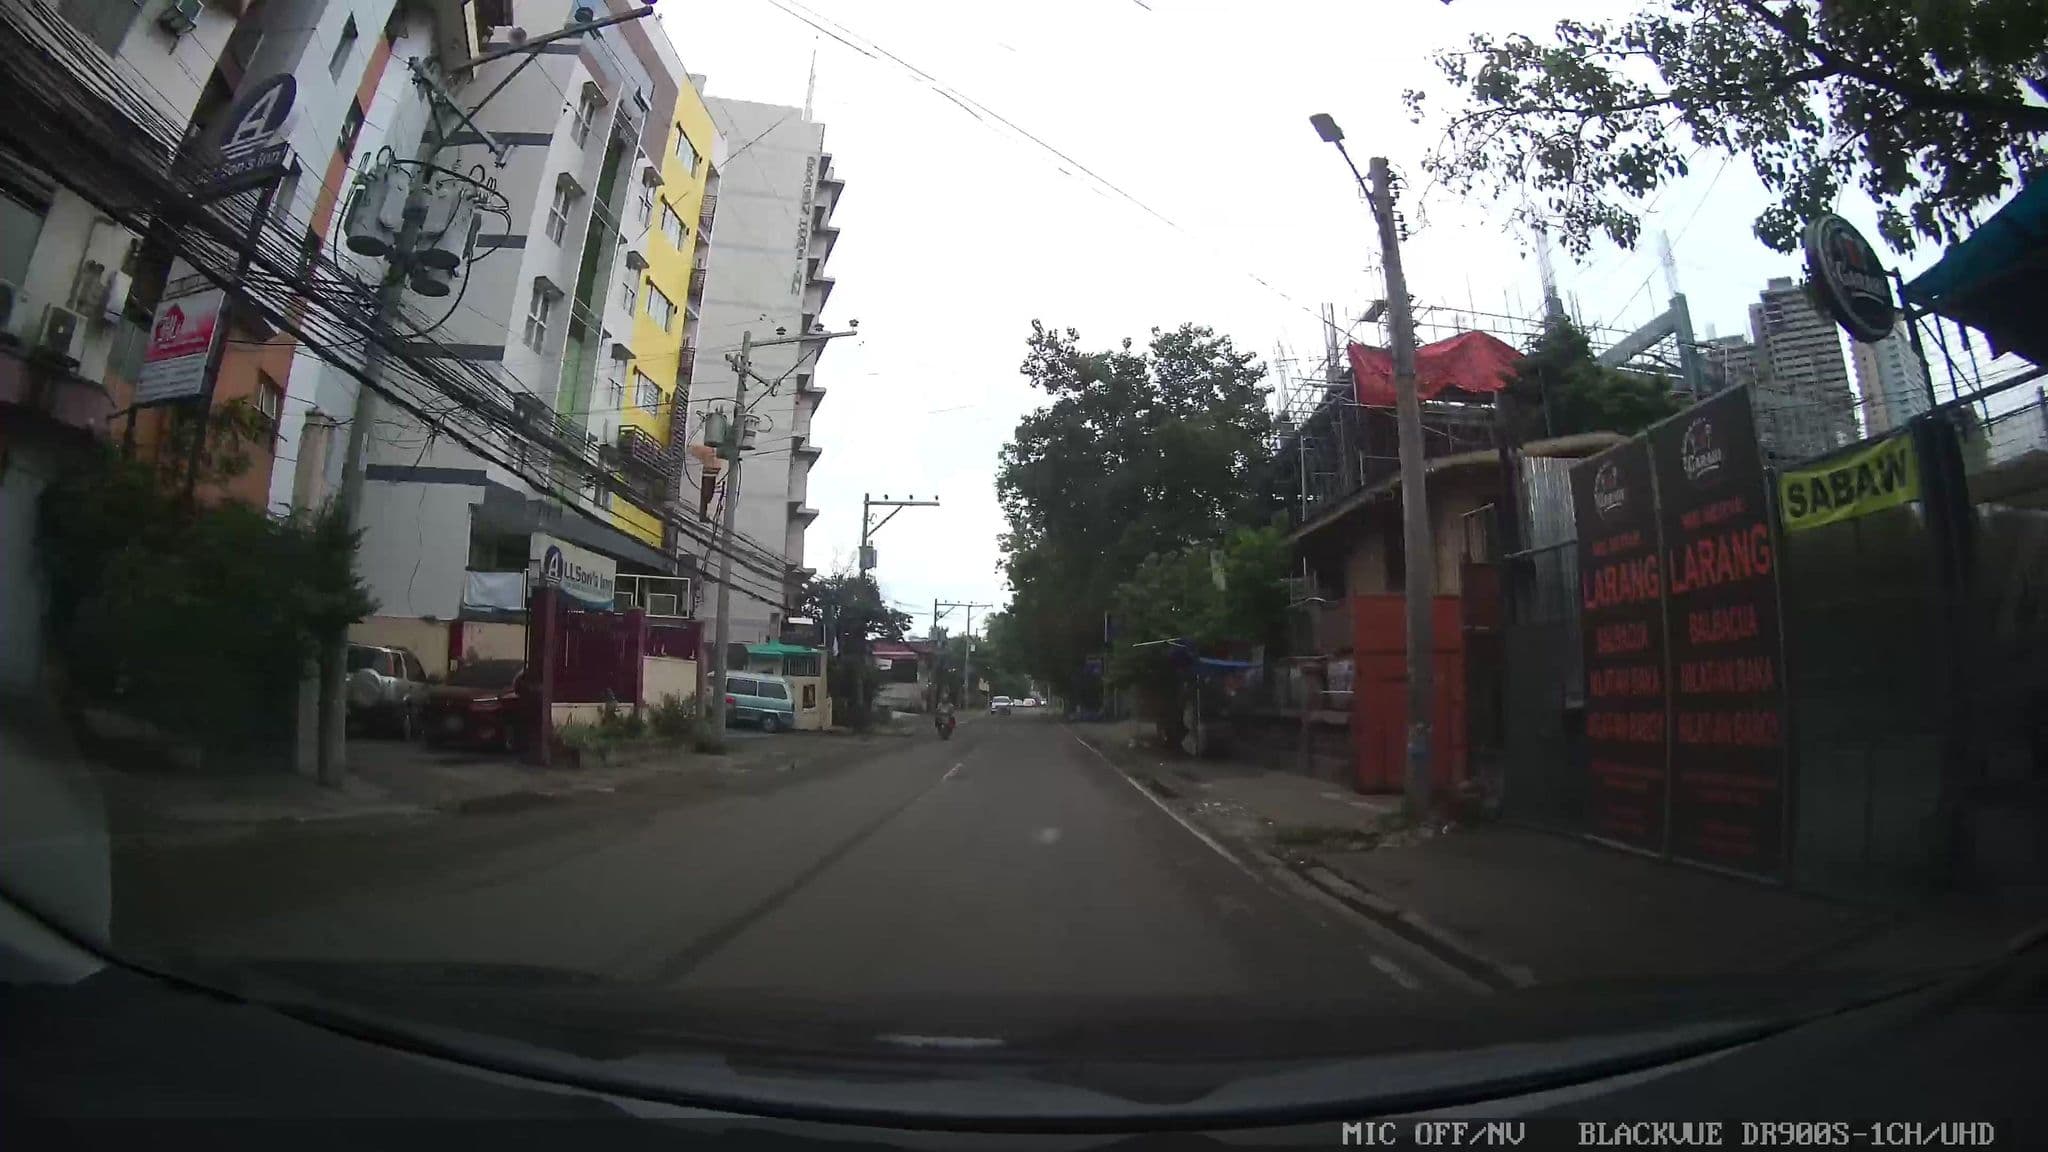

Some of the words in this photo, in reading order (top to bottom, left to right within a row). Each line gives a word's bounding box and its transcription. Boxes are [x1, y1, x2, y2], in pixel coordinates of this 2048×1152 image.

[1786, 446, 1908, 519] SABAW
[1584, 555, 1659, 609] LARANG
[1670, 524, 1771, 593] LARANG
